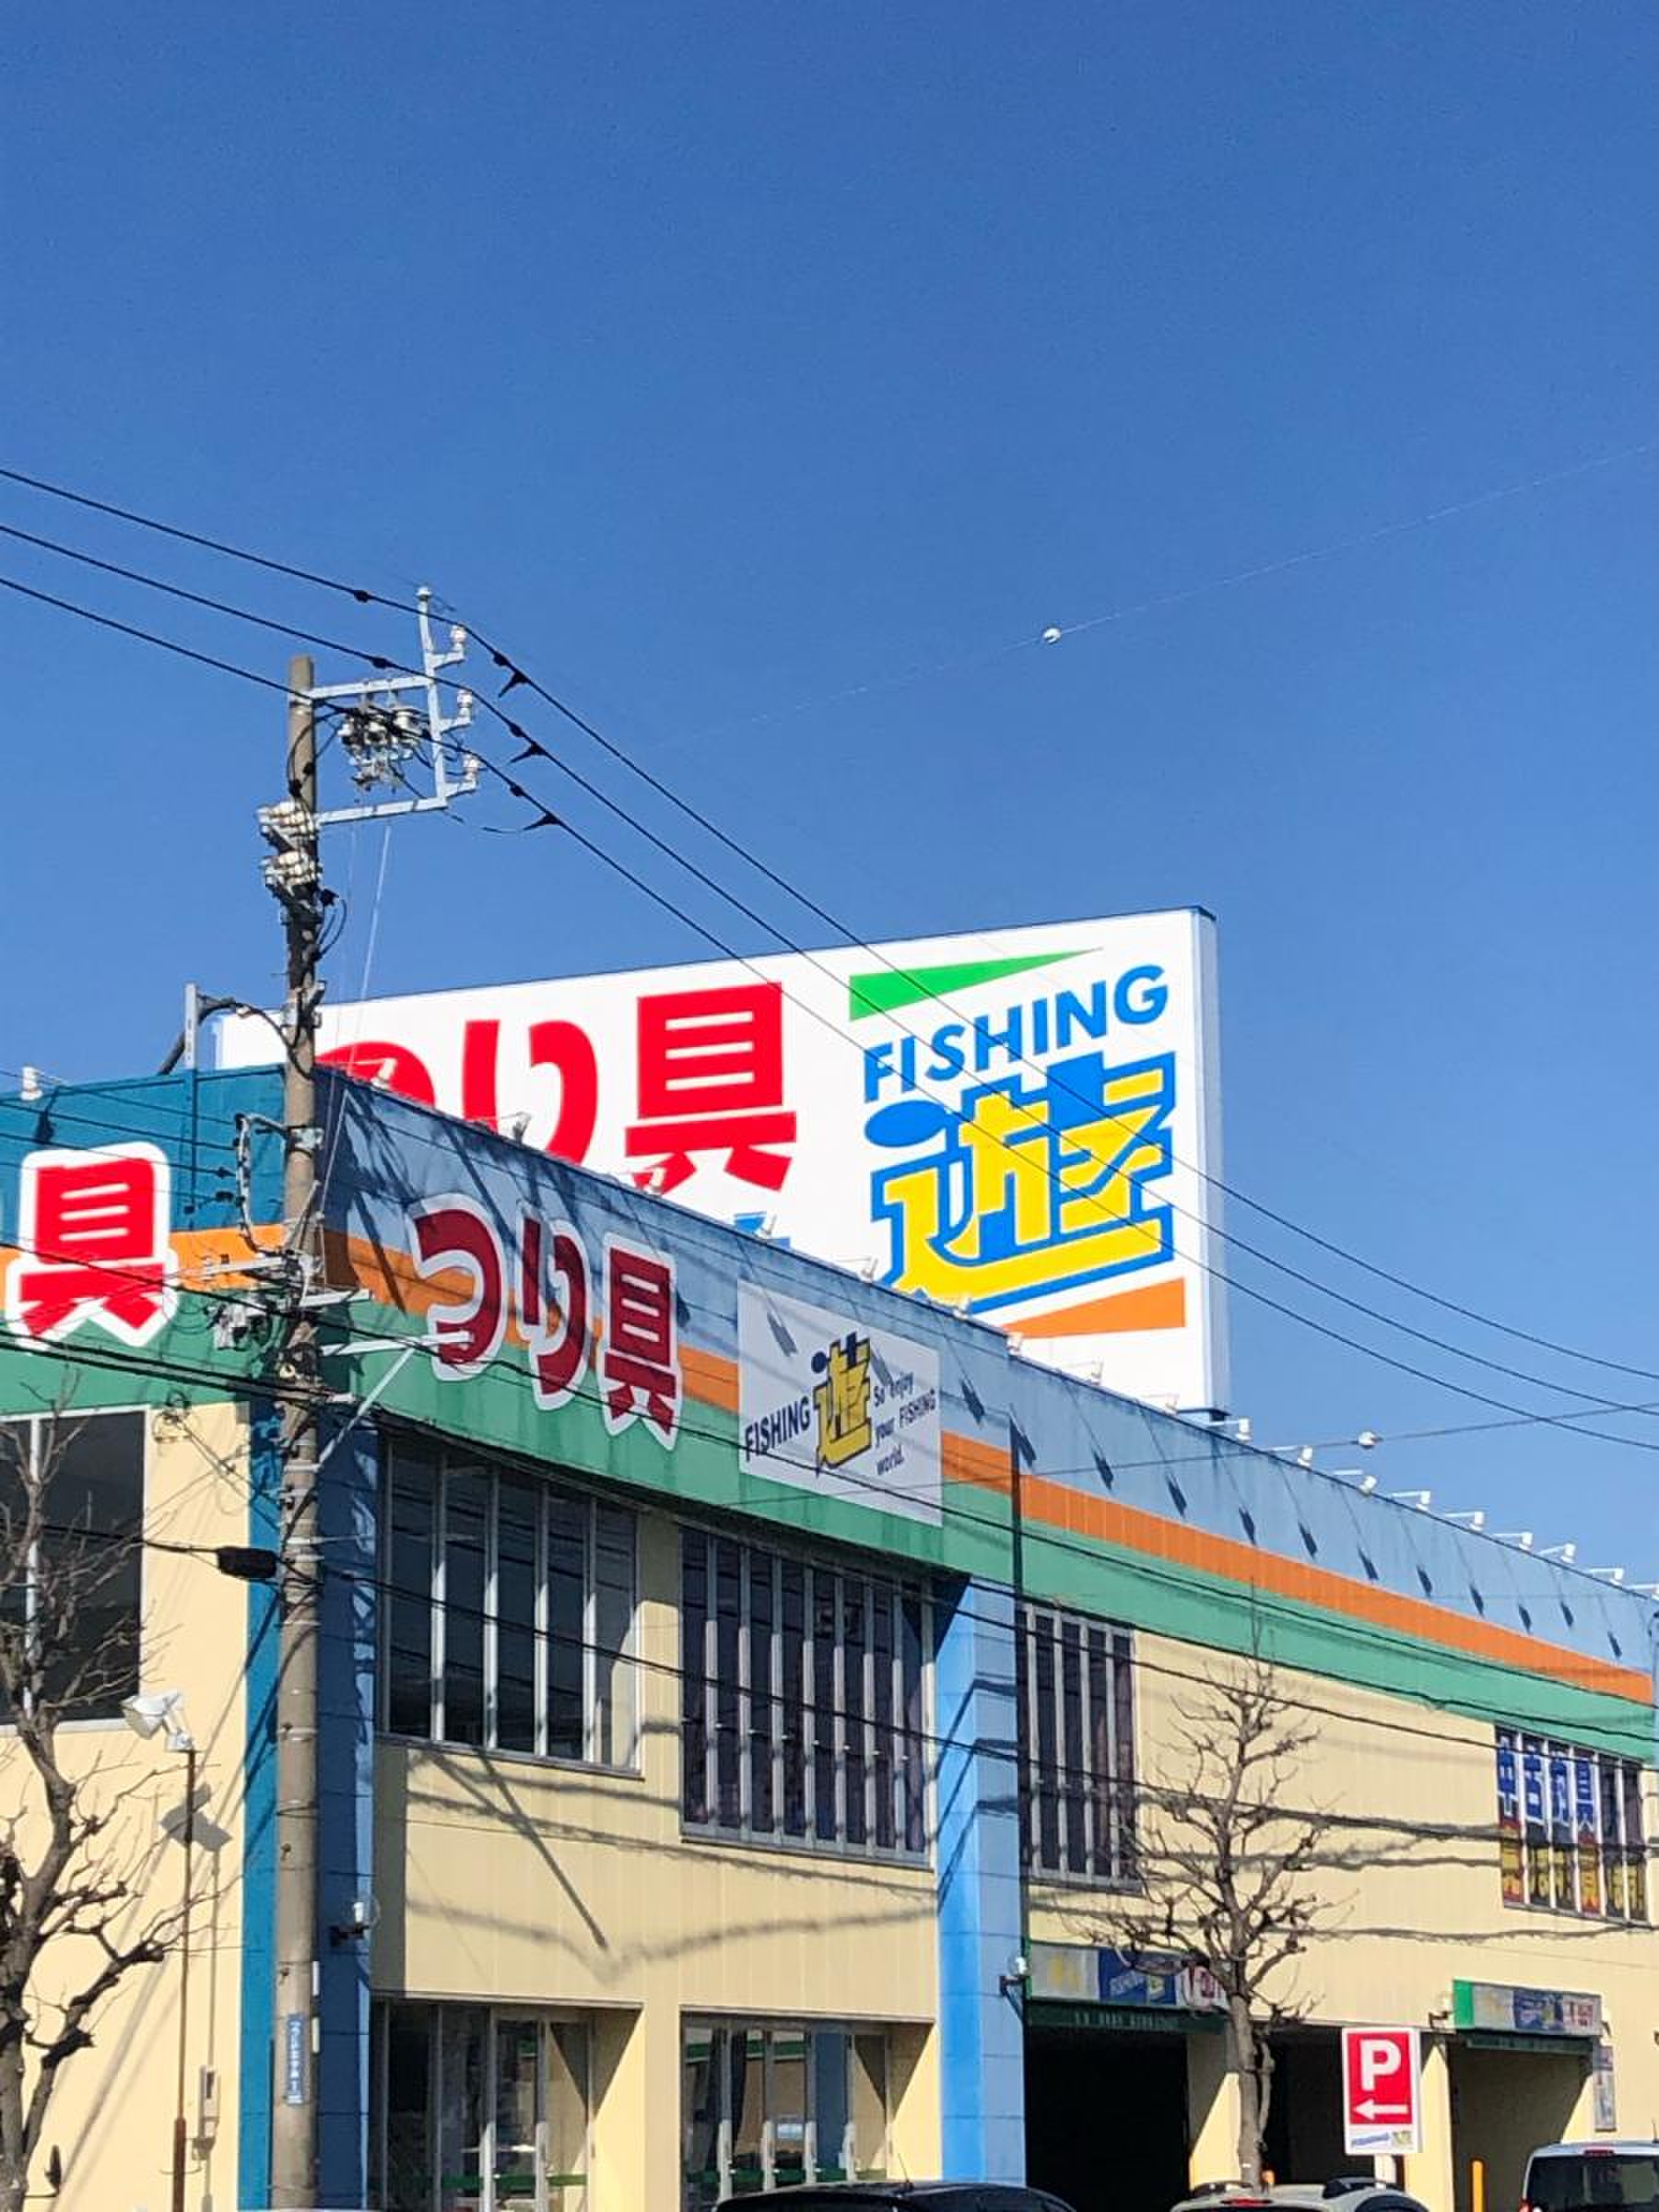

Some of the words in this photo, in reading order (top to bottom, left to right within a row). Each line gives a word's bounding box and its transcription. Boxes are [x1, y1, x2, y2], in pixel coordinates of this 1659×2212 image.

[864, 965, 1168, 1103] FISHING
[865, 1051, 1175, 1314] 遊
[19, 1158, 164, 1336] 具
[414, 1207, 677, 1435] つり具
[745, 1397, 810, 1462] FISHING
[874, 1385, 885, 1407] So
[890, 1371, 913, 1399] enjoy
[877, 1418, 895, 1448] your
[899, 1388, 936, 1428] FISHING
[1360, 2040, 1402, 2091] P
